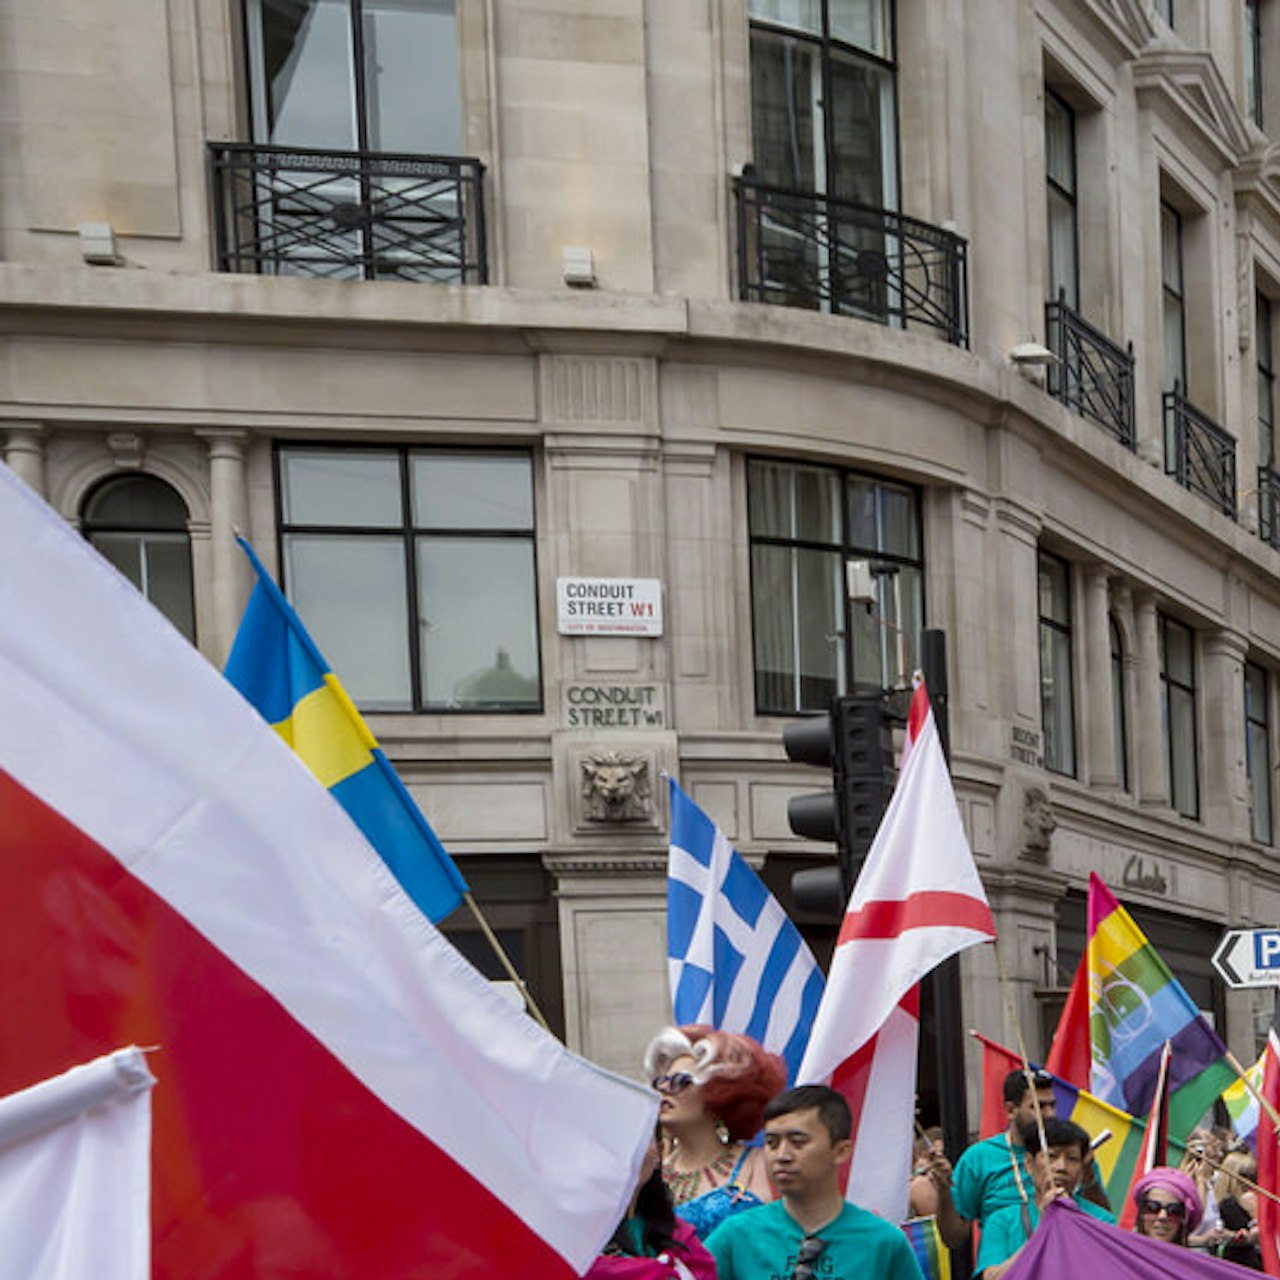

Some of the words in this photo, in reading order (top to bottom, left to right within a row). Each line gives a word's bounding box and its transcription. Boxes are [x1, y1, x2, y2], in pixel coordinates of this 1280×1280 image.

[566, 583, 634, 599] CONDUIT
[568, 601, 624, 616] STREET
[629, 602, 654, 617] W1
[567, 687, 656, 705] CONDUIT
[568, 708, 640, 726] STREET
[784, 1255, 834, 1275] FG
